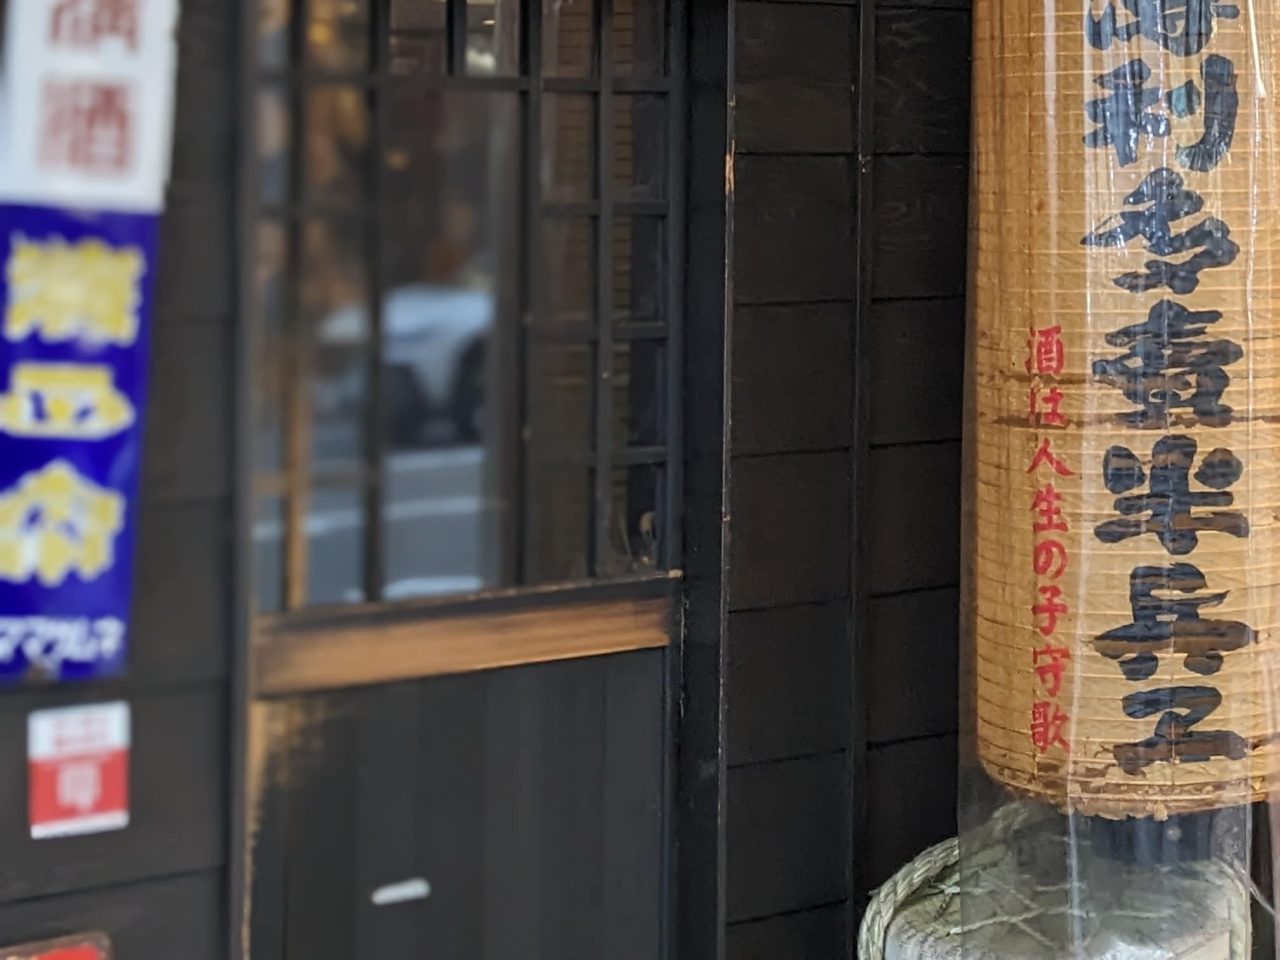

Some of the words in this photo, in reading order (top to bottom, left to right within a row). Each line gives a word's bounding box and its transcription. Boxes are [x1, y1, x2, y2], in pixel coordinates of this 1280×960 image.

[1025, 325, 1074, 753] 酒は人生の子守歌
